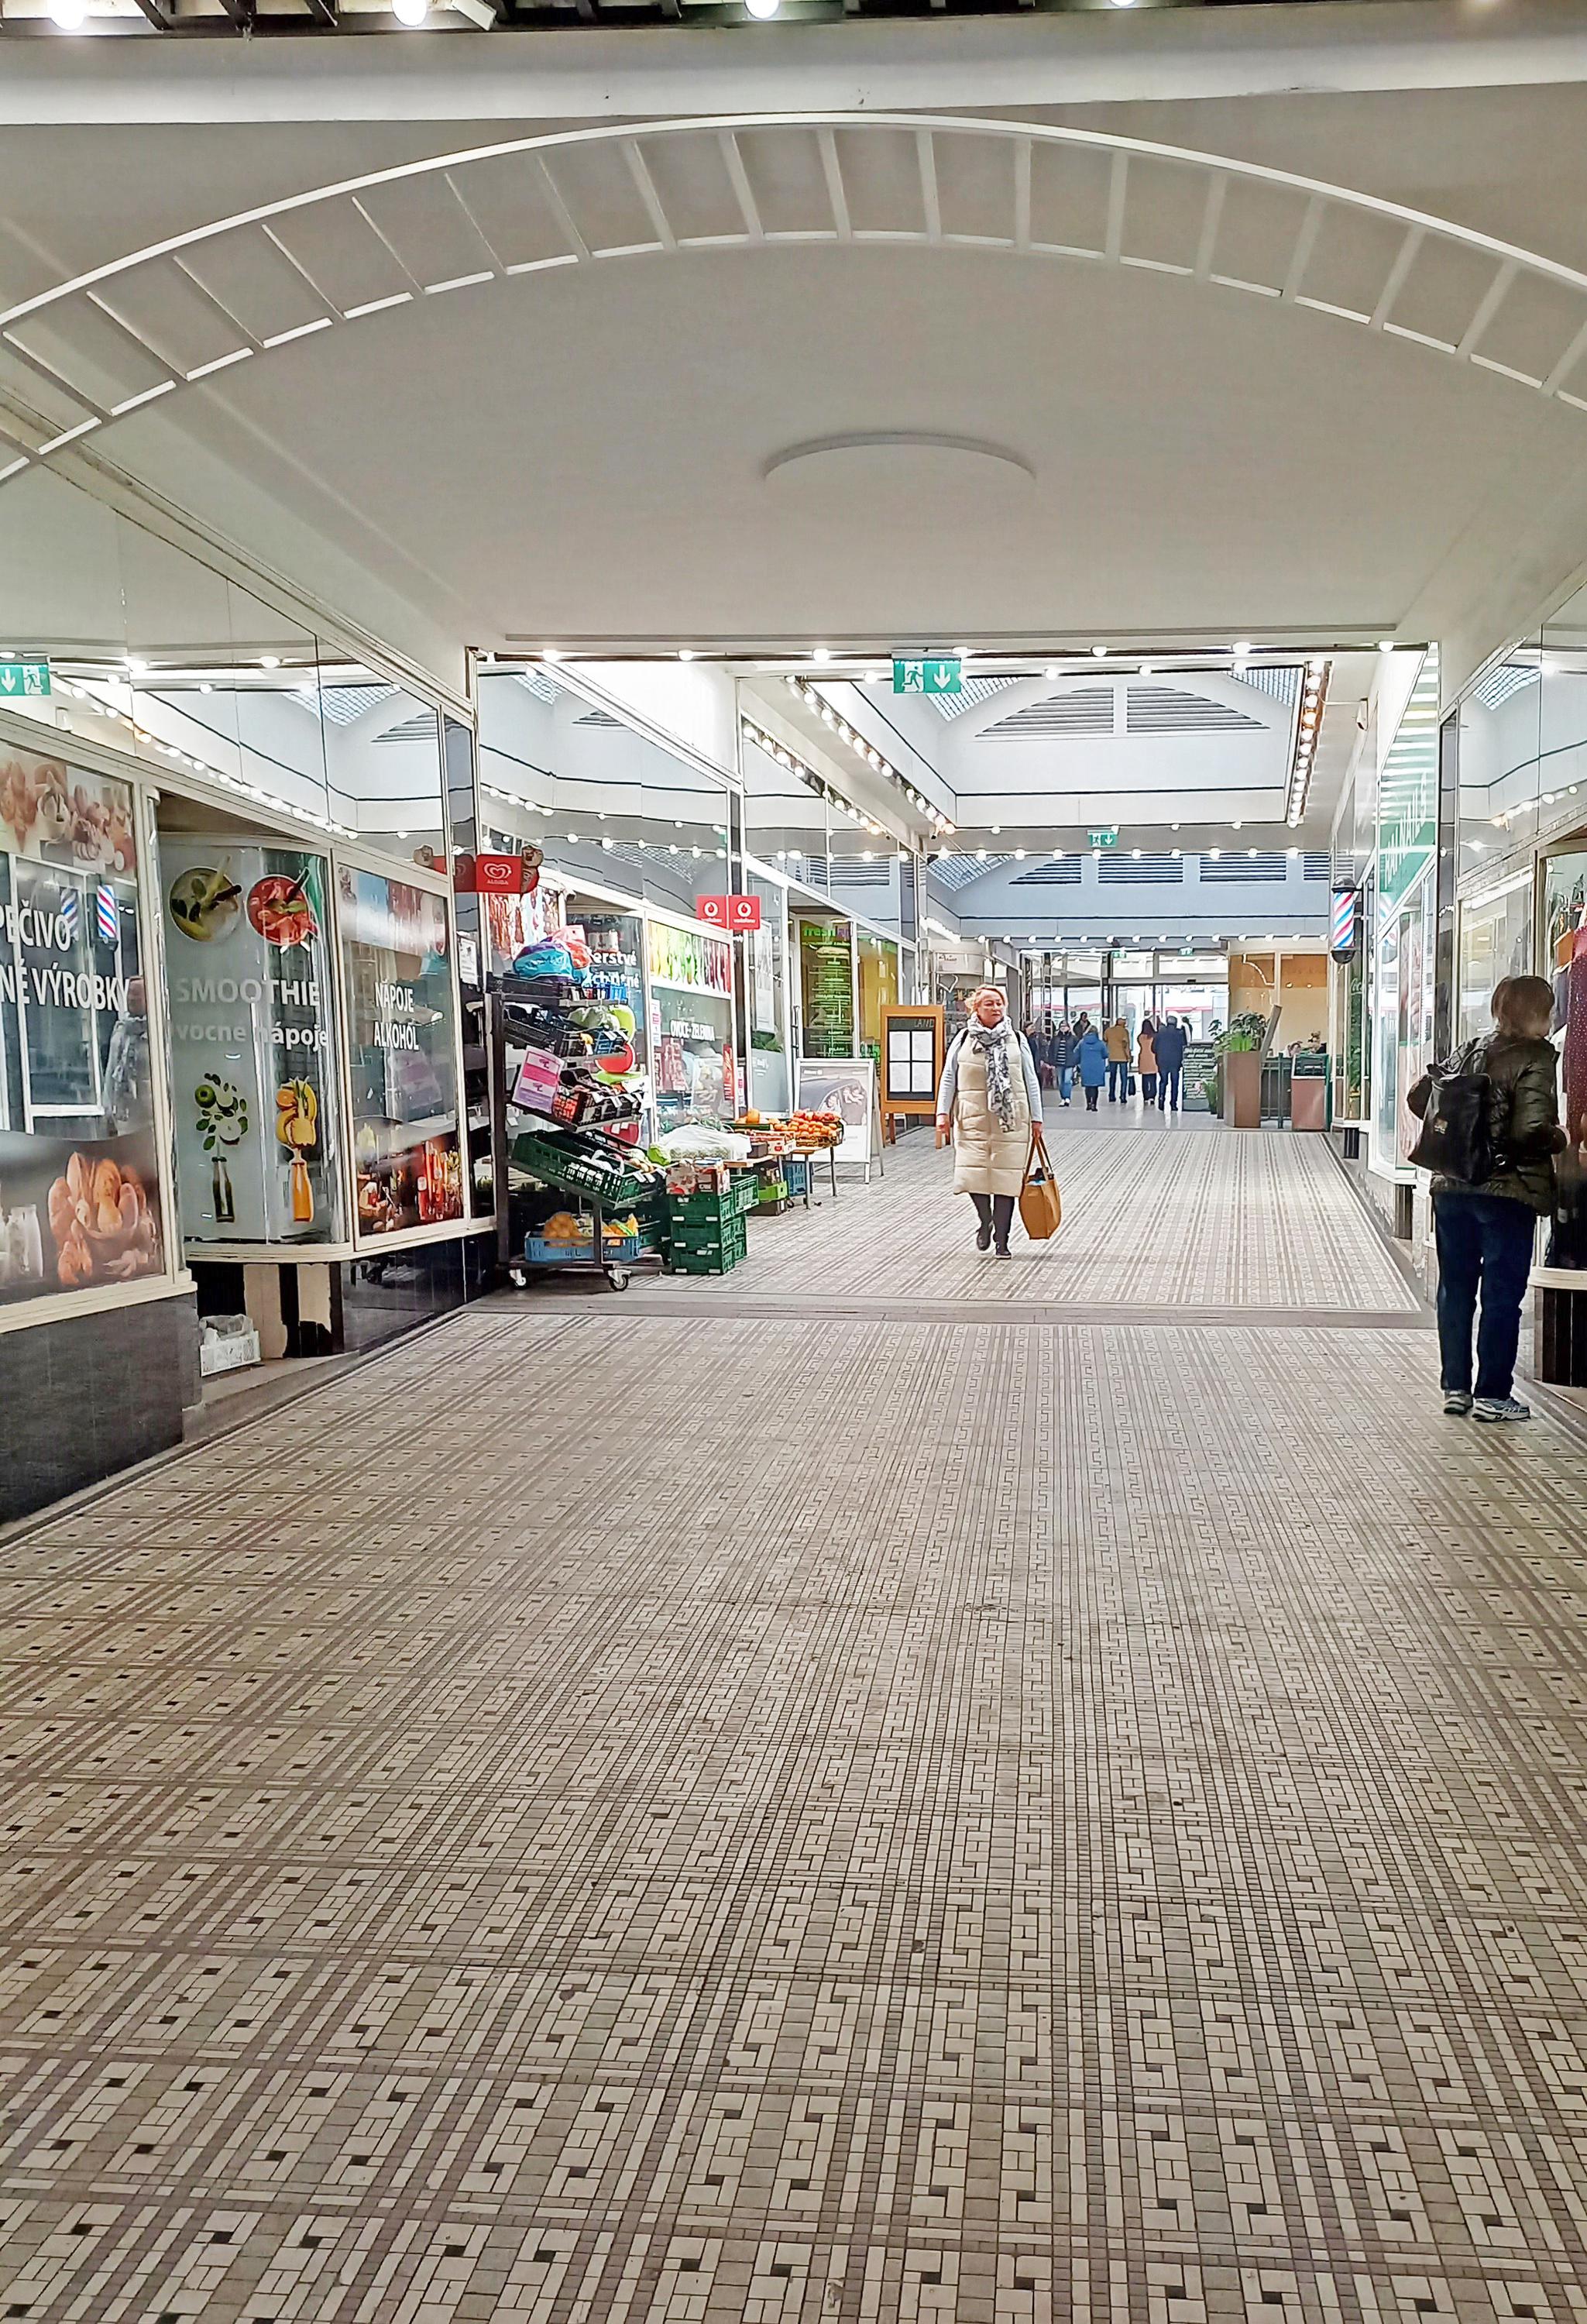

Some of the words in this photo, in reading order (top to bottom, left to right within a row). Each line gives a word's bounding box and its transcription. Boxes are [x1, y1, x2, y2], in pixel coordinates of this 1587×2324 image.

[592, 951, 637, 966] erstvé
[31, 962, 129, 1014] VÝROBKY
[176, 978, 320, 1006] SMOOTHIE
[375, 978, 414, 1012] NÁPOJE
[256, 1021, 328, 1052] nápoje
[374, 1021, 420, 1050] ALKOHOL
